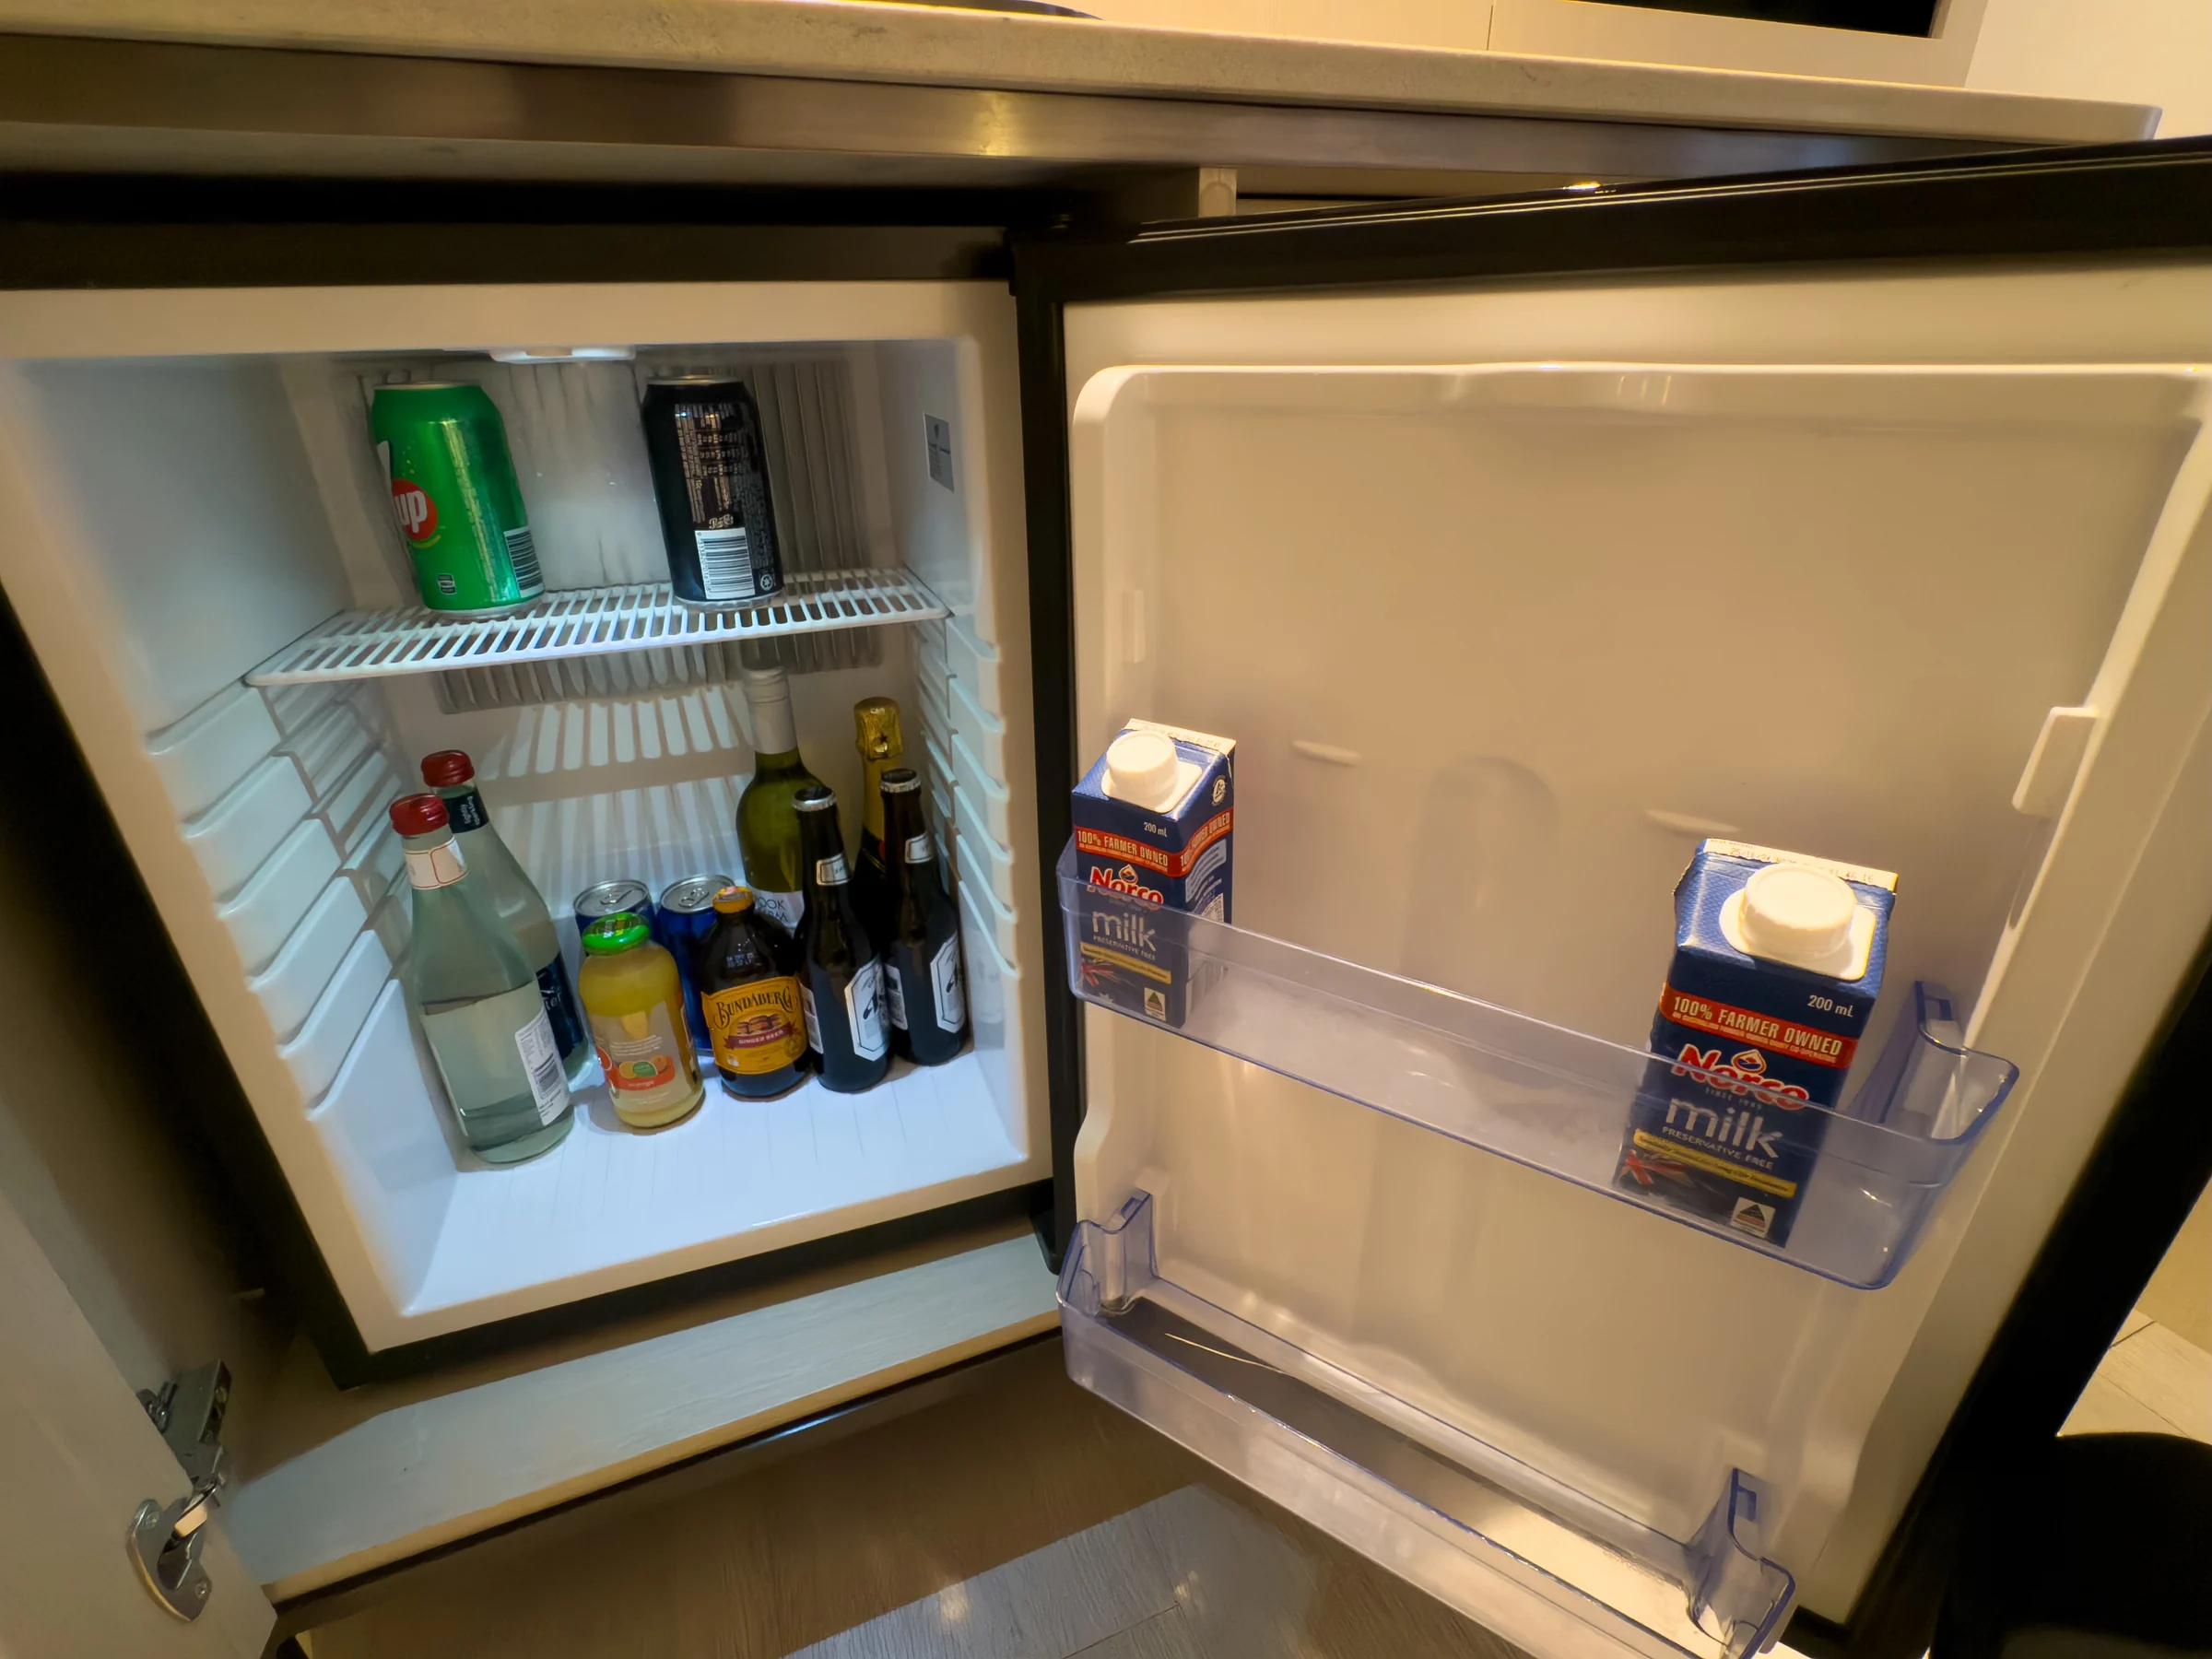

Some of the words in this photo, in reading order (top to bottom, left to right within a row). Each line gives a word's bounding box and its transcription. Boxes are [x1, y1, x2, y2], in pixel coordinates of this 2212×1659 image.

[1077, 830, 1101, 846] 100%
[1104, 836, 1137, 855] FARMER
[1140, 846, 1168, 865] OWNED
[1144, 822, 1156, 833] 200
[758, 897, 786, 911] OOK
[1088, 866, 1164, 911] Norco
[1092, 911, 1157, 952] milk
[1093, 935, 1139, 955] PRESERVATIVE
[713, 985, 794, 1030] BUNDABERG
[1806, 994, 1832, 1012] 200
[739, 1036, 765, 1044] GINGER
[1674, 996, 1712, 1020] 100%
[1718, 1008, 1781, 1039] FARMER
[1784, 1028, 1842, 1056] OWNED
[1671, 1043, 1809, 1110] Norco
[1665, 1097, 1784, 1158] milk
[1663, 1126, 1741, 1159] PRESERVATIVE
[1746, 1154, 1773, 1171] FREE
